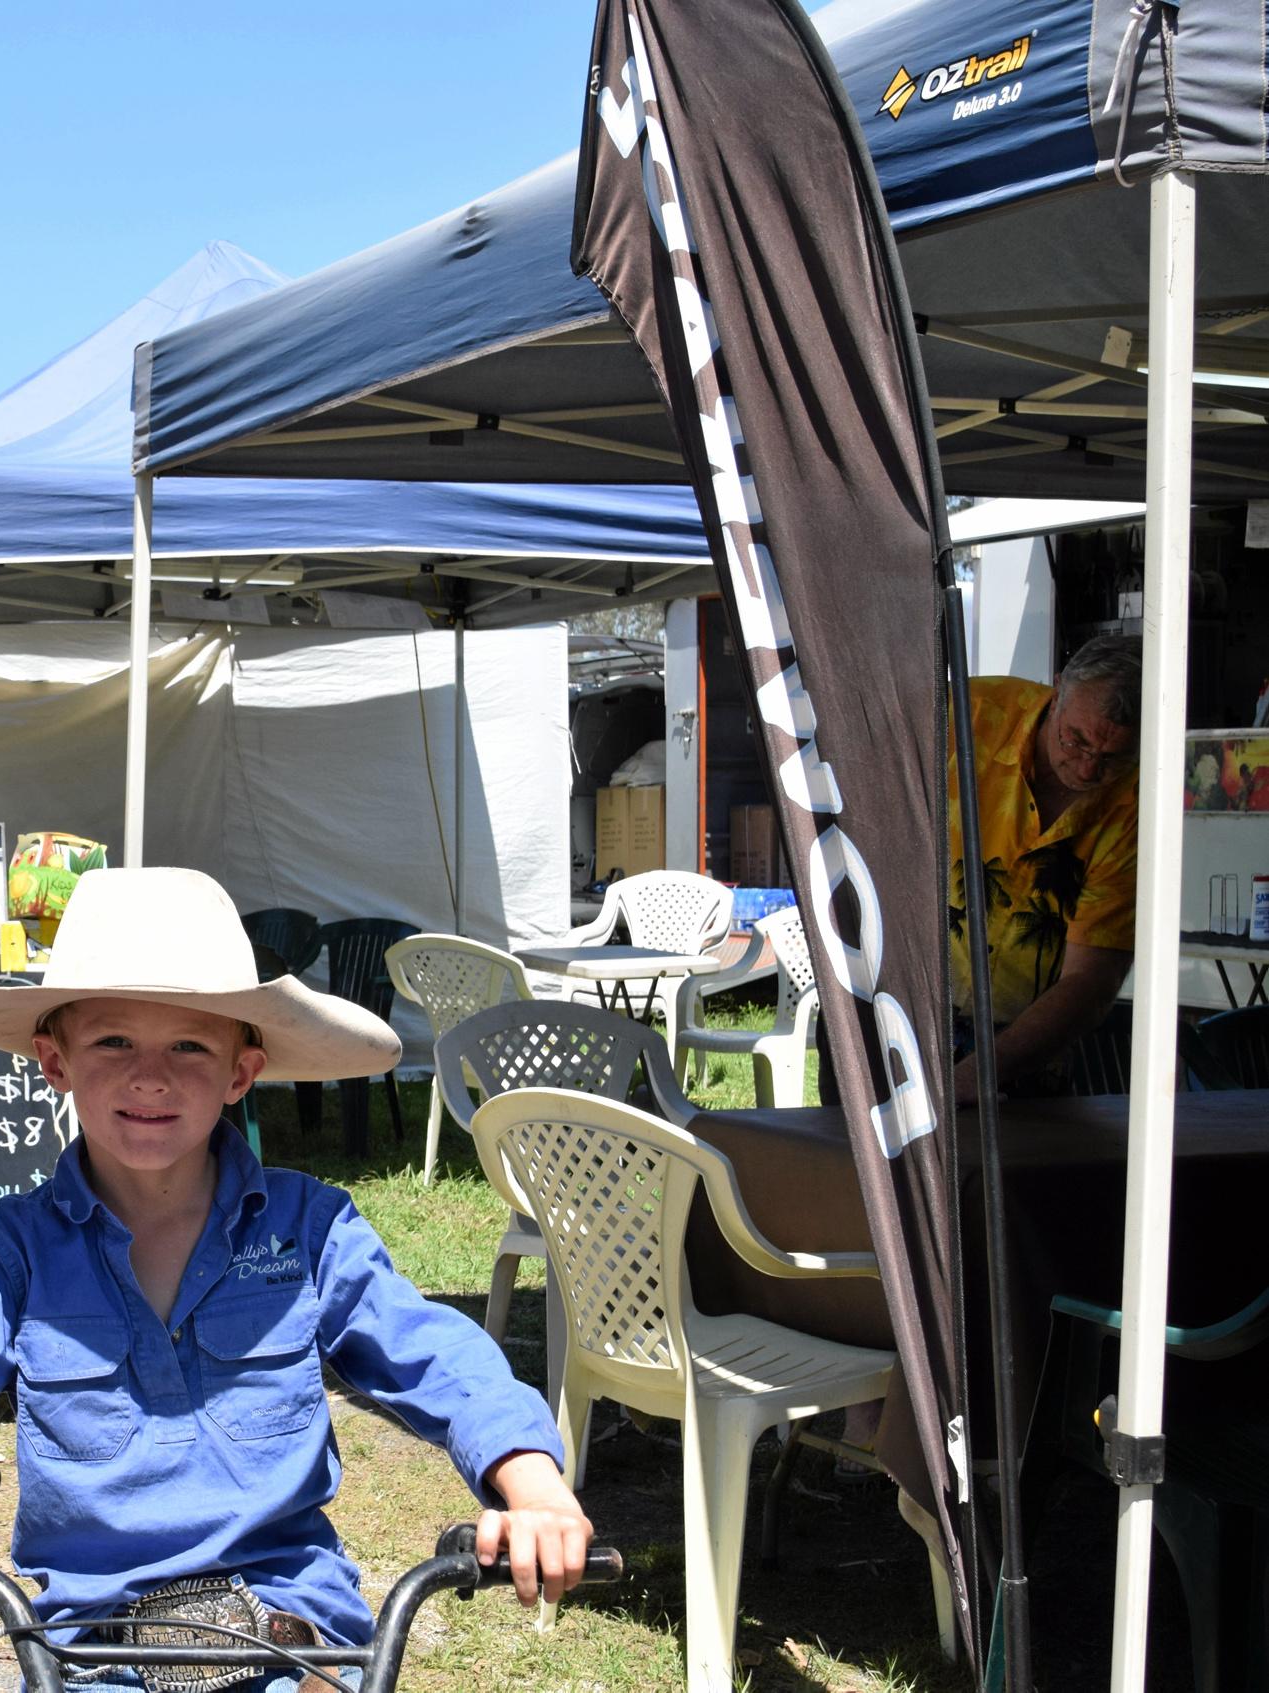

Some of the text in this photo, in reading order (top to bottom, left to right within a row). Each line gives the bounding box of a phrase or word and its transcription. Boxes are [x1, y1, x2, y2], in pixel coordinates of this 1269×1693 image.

[920, 35, 1031, 101] OZtrail
[952, 82, 1023, 121] Deluxe 3.0
[225, 1257, 301, 1280] Dream
[266, 1271, 304, 1285] Be Kind
